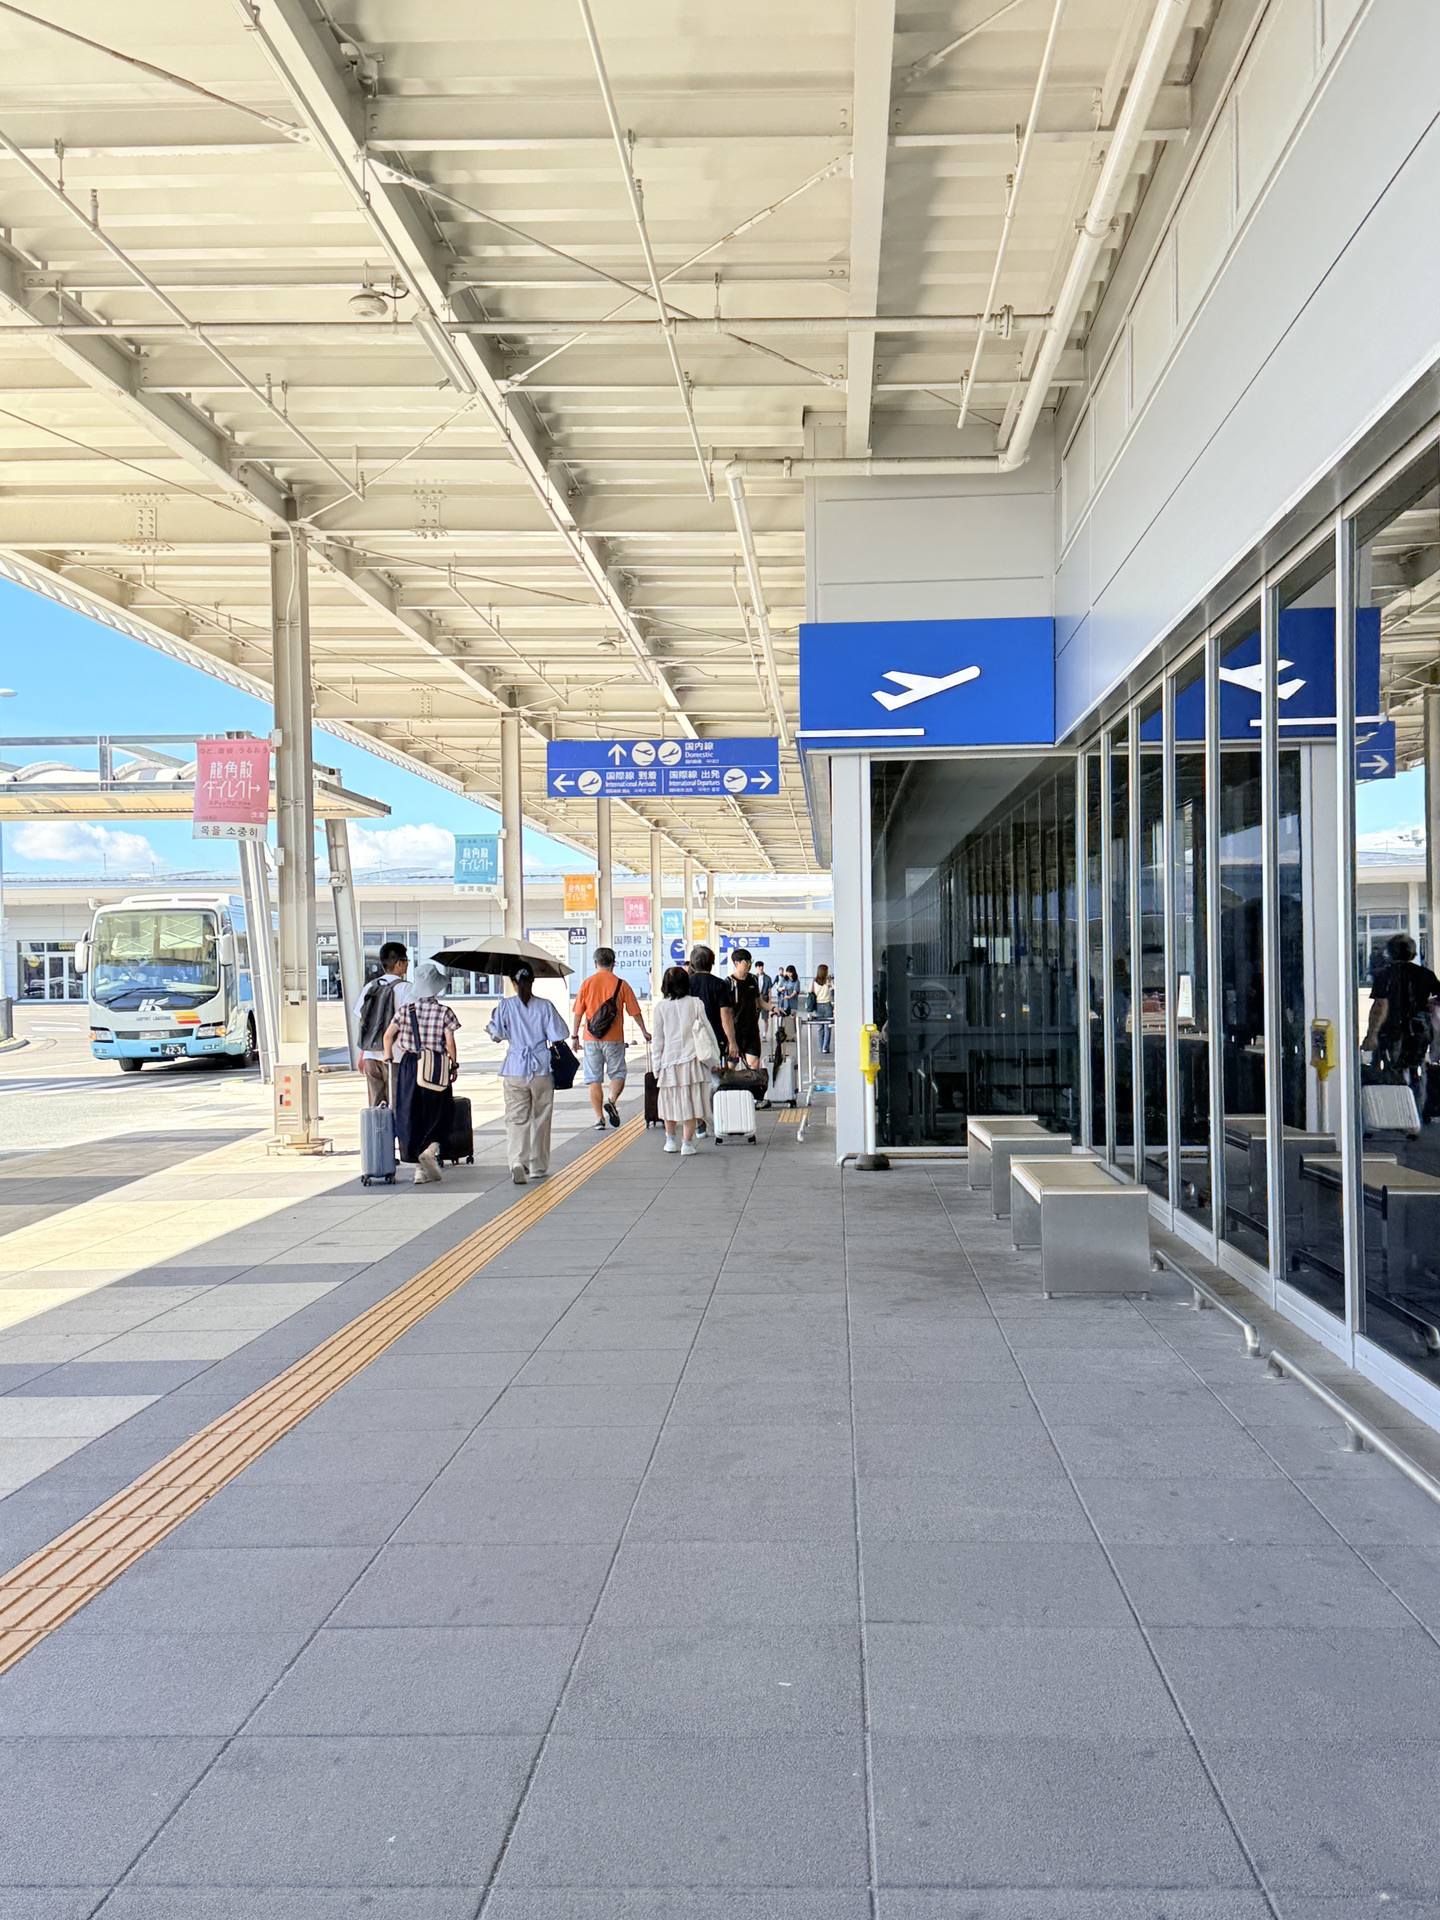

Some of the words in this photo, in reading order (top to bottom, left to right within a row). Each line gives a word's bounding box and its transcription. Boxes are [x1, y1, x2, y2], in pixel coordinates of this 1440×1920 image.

[684, 742, 714, 751] 国内線
[210, 760, 253, 779] 龍角散
[606, 771, 634, 780] 国際線
[638, 771, 657, 780] 到着
[669, 770, 698, 779] 国際線
[701, 770, 720, 779] 出発
[202, 780, 261, 799] ダイレクト
[226, 827, 258, 838] 소중히
[576, 928, 585, 936] T1
[614, 935, 642, 945] 国際線
